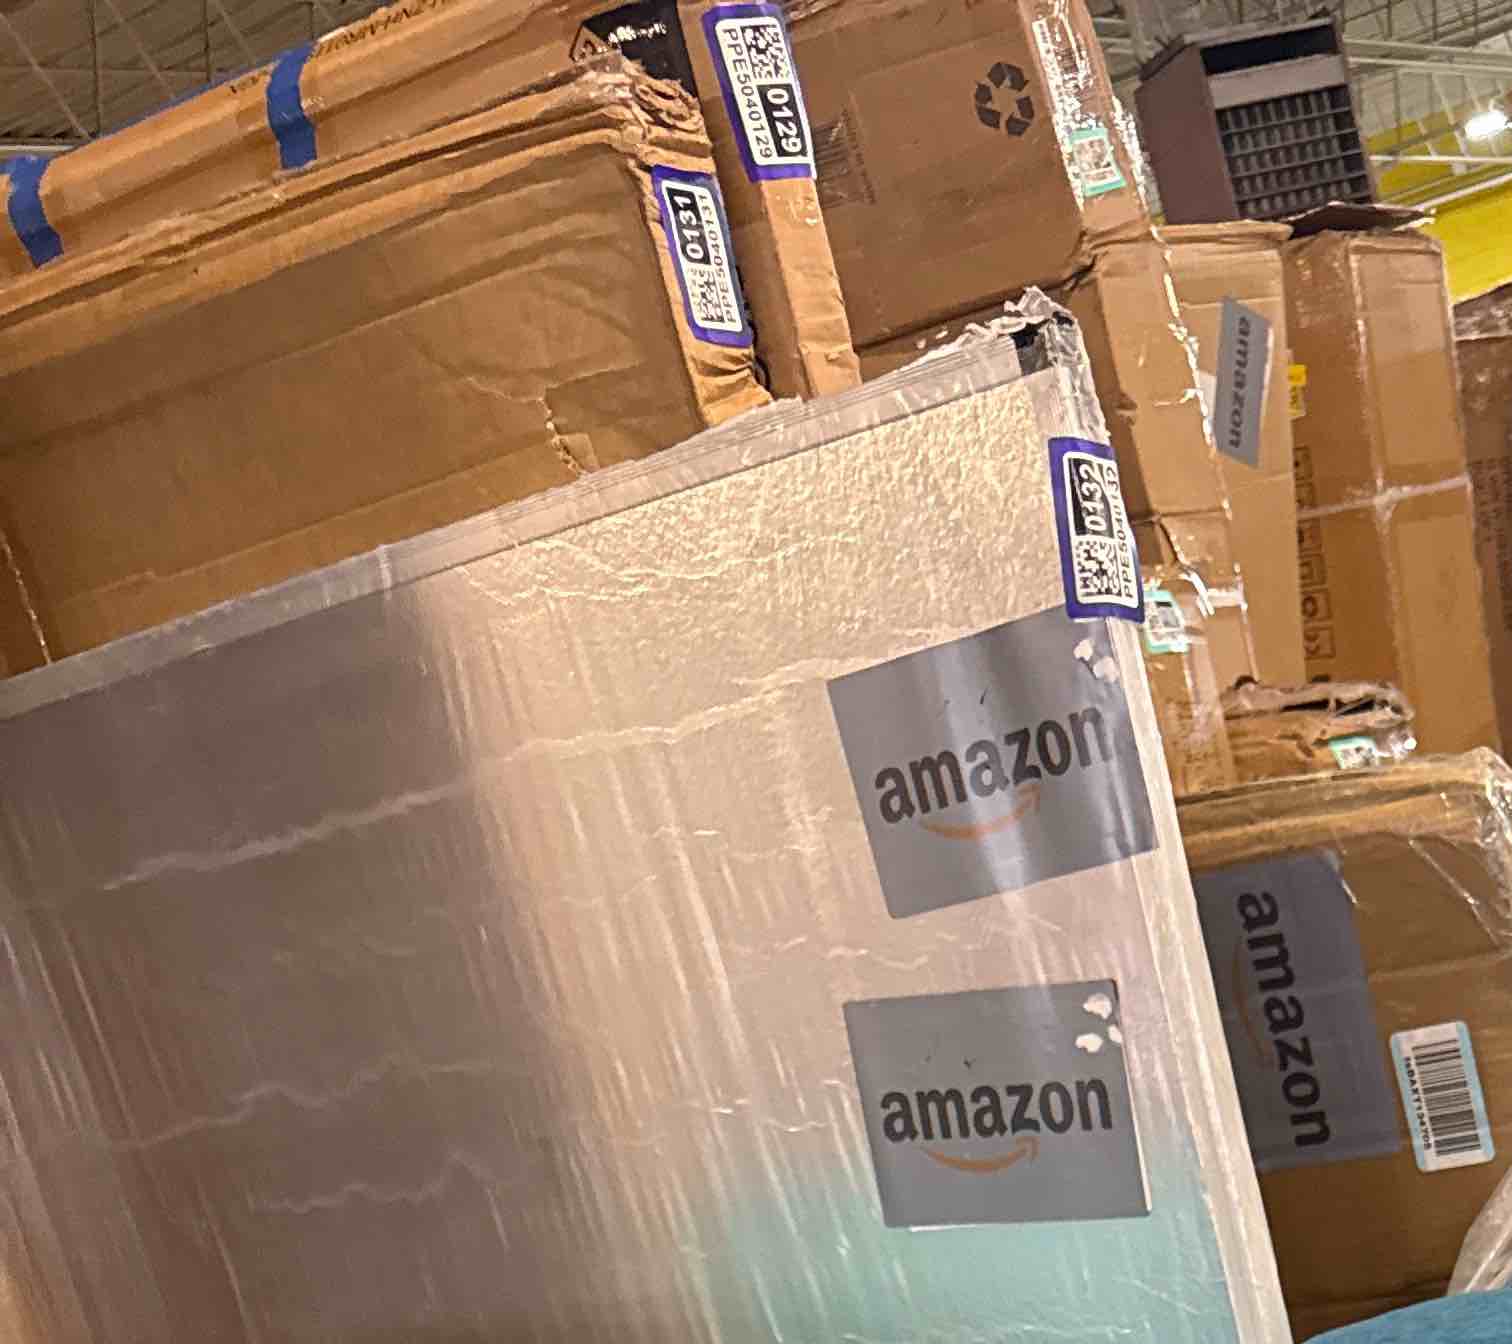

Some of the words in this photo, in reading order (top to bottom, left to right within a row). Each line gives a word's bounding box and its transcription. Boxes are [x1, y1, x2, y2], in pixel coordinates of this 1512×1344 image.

[722, 28, 773, 159] PPE5040129
[766, 88, 803, 154] 0129
[673, 194, 705, 260] 0131
[698, 192, 737, 323] PPE5040131
[1228, 316, 1252, 449] amazon
[1078, 462, 1108, 533] 0132
[1104, 464, 1135, 600] PPE5040132
[874, 706, 1112, 824] amazon
[1237, 890, 1332, 1149] amazon
[880, 1076, 1114, 1144] amazon
